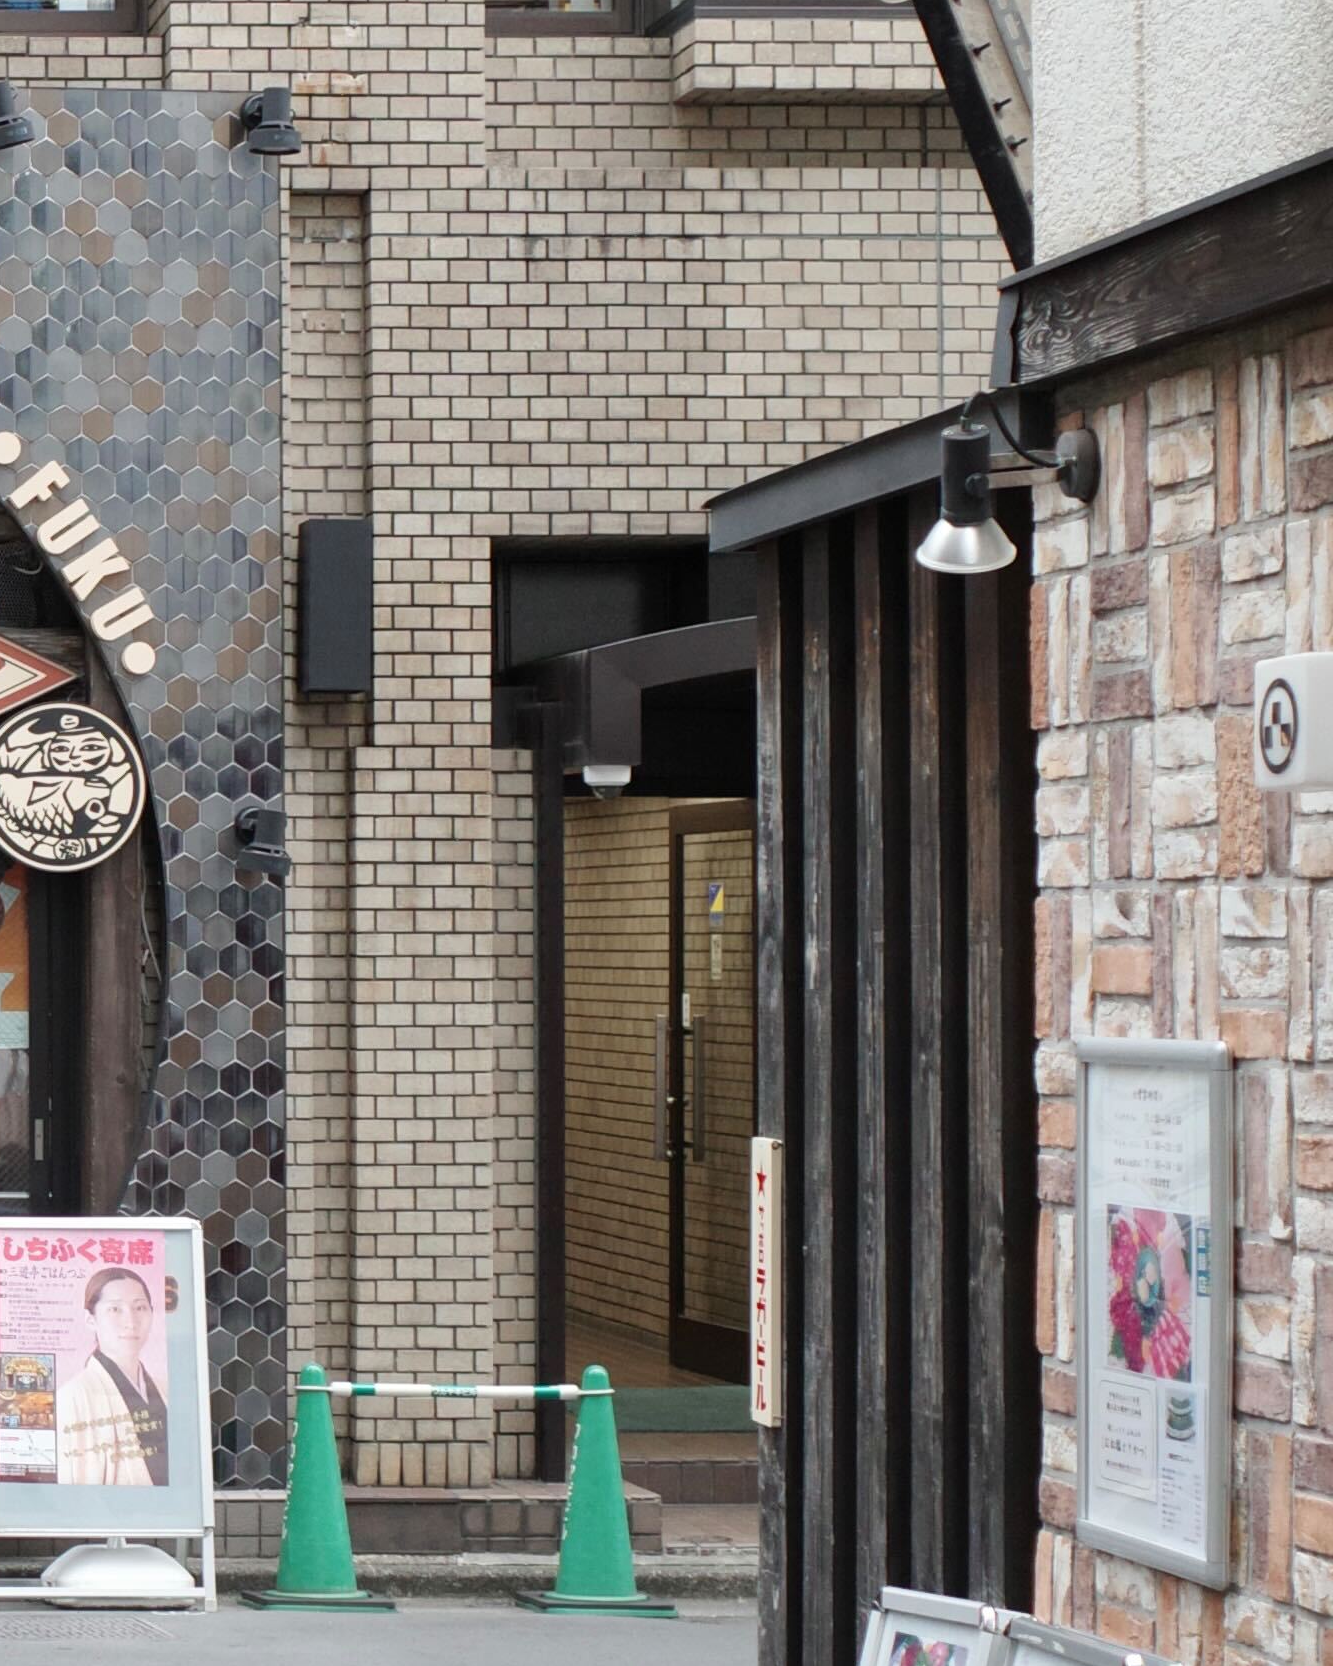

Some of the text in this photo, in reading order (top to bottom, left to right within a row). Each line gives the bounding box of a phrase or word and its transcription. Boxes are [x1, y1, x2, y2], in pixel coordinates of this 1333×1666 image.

[7, 457, 158, 644] FUKU
[2, 1236, 155, 1265] しちふく寄席
[755, 1268, 767, 1412] ラガービール
